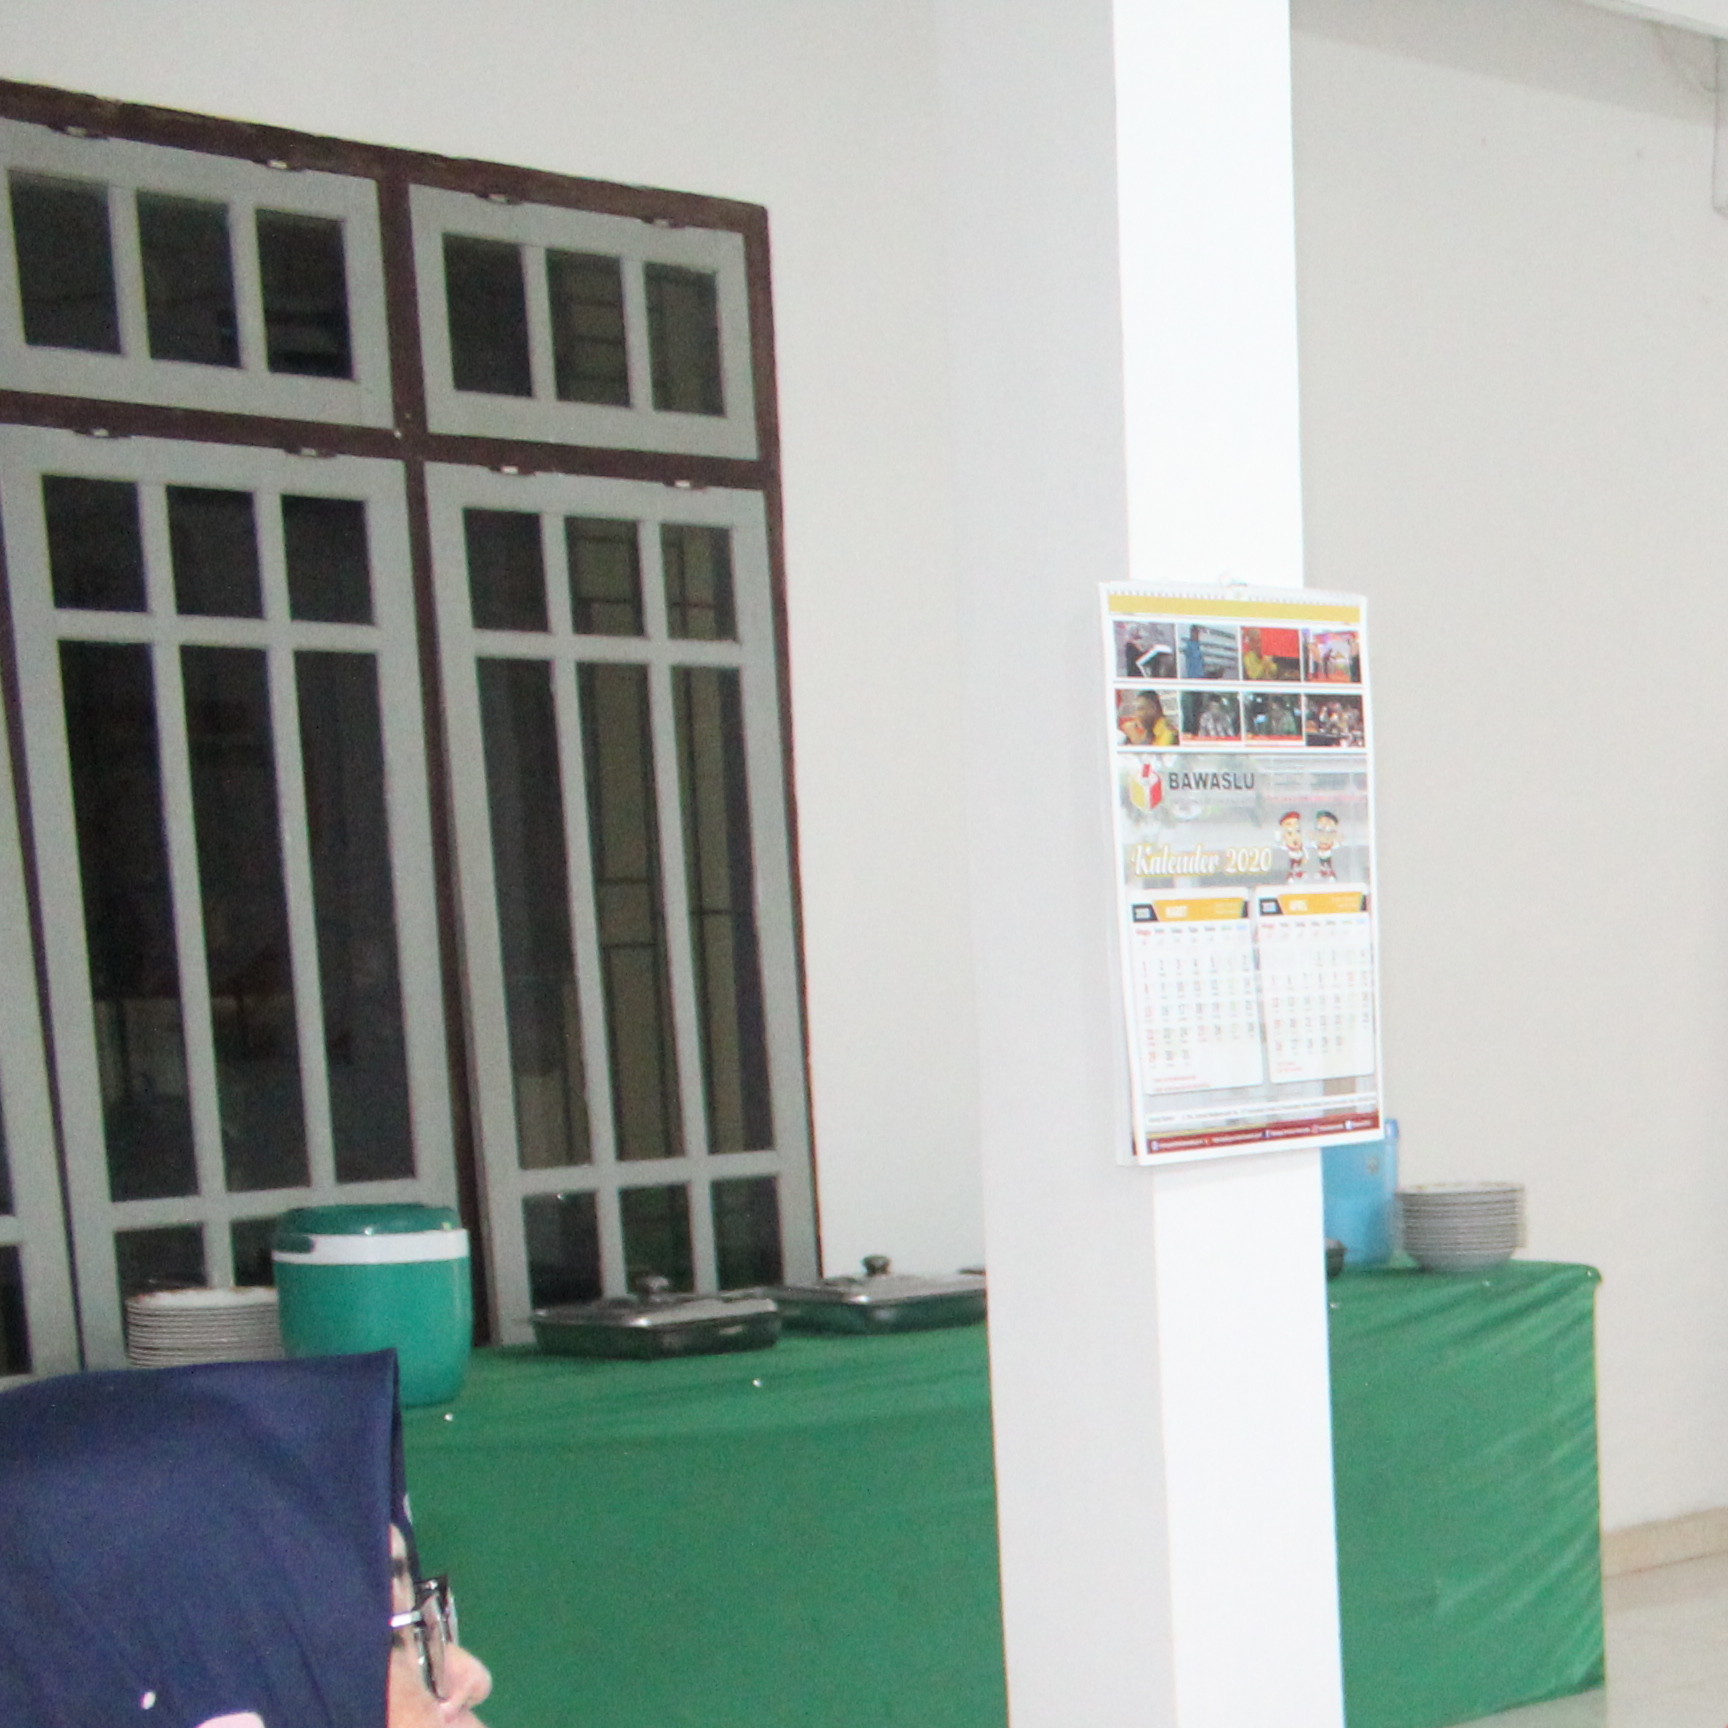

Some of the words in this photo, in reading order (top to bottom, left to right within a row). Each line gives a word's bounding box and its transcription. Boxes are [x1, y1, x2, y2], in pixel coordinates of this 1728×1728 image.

[1168, 771, 1255, 790] BAWASLU
[1132, 844, 1220, 876] Kalender
[1225, 846, 1272, 875] 2020
